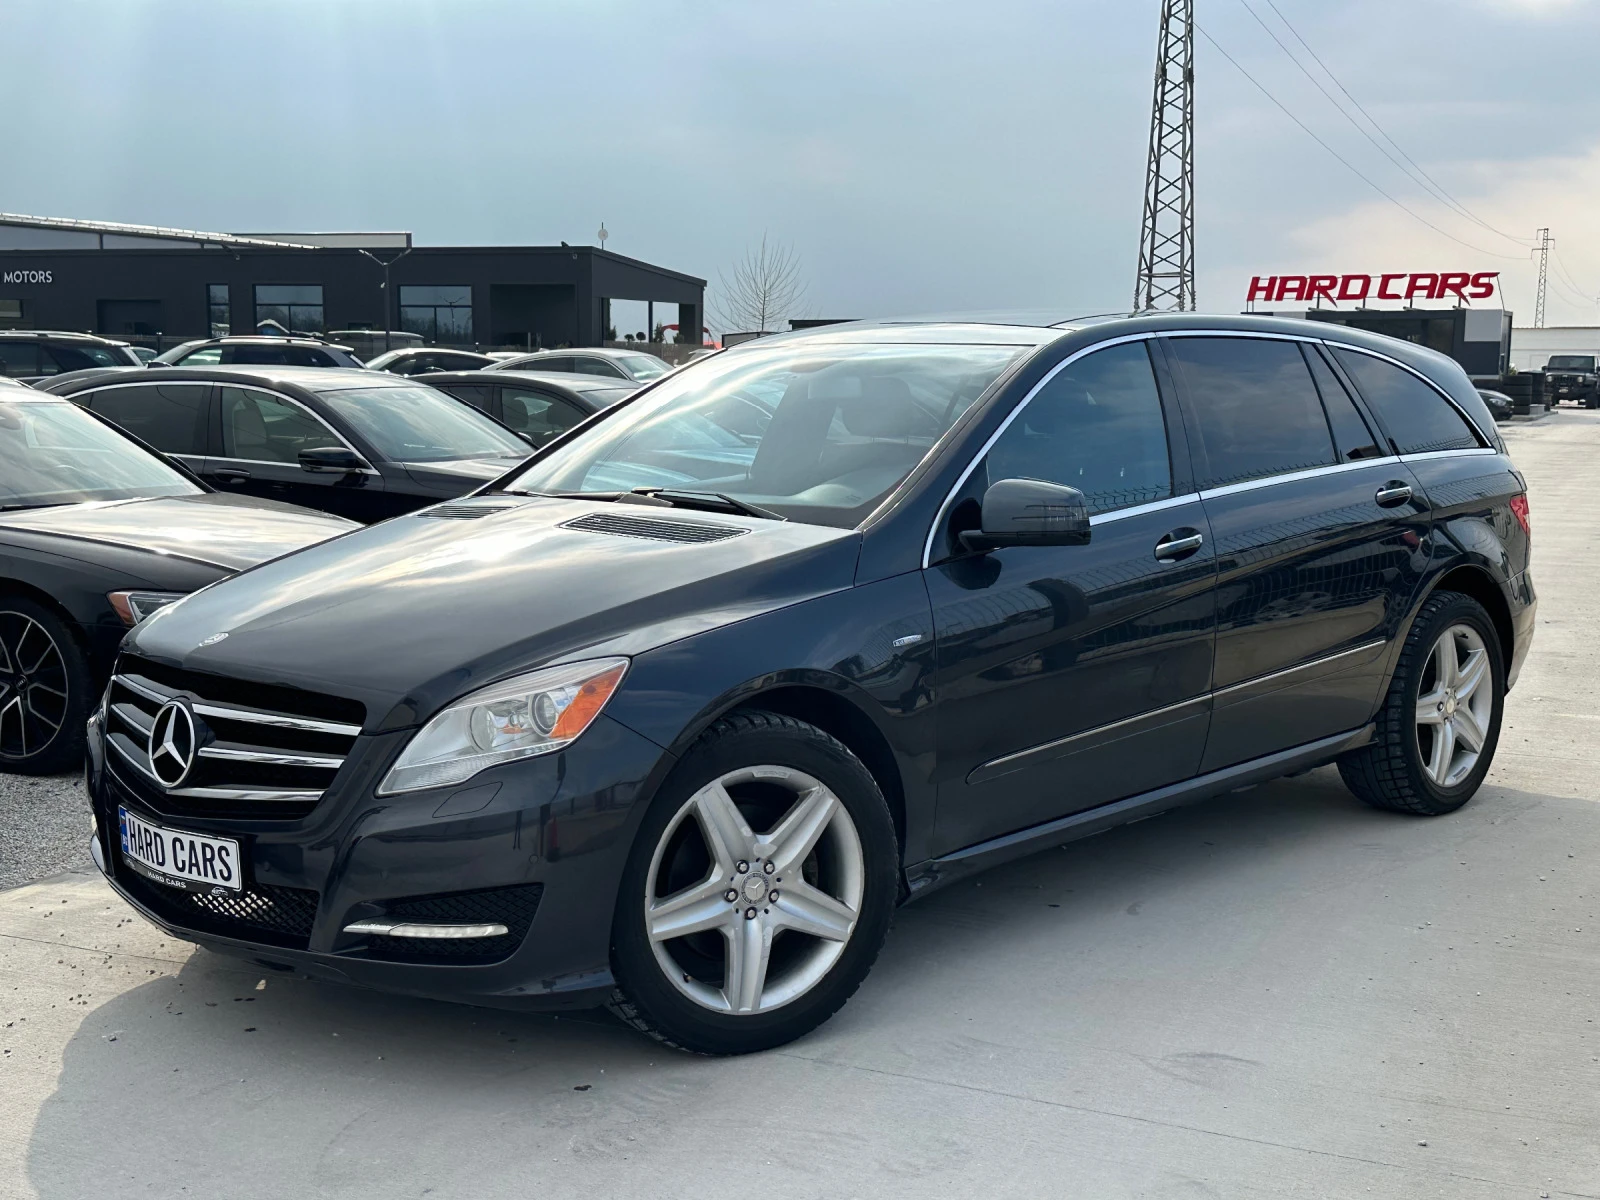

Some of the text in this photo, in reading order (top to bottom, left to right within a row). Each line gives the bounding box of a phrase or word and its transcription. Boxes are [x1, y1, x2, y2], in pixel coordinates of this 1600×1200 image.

[4, 270, 53, 283] MOTORS
[1246, 271, 1501, 308] HARD CARS
[128, 818, 233, 882] HARD CARS
[147, 870, 187, 889] HARD CARS
